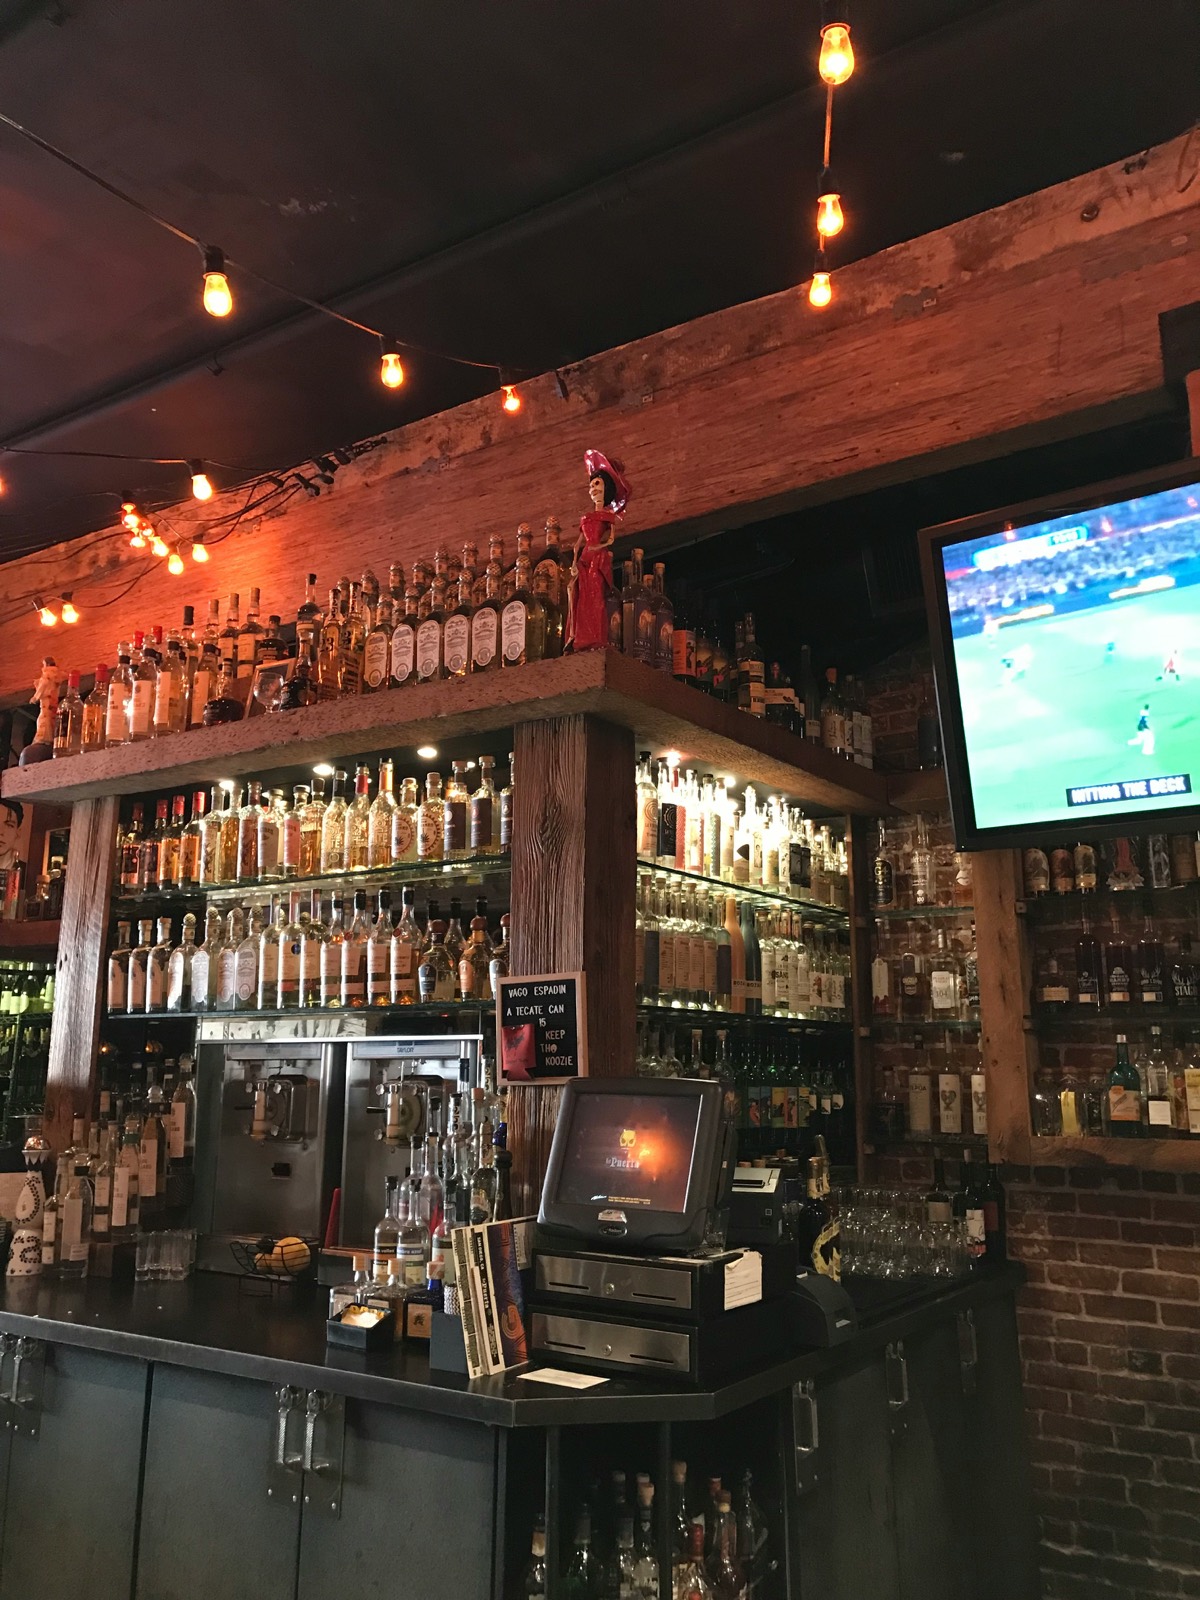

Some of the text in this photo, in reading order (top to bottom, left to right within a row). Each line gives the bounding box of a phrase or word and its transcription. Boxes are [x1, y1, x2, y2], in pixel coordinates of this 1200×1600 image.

[1123, 781, 1148, 798] THE
[1149, 776, 1187, 795] DECK
[508, 984, 567, 999] VAGO ESPADIN
[506, 1004, 565, 1016] A TECATE CAN
[538, 1018, 546, 1027] 15
[545, 1029, 566, 1040] KEEP
[545, 1055, 574, 1066] KOOZIE
